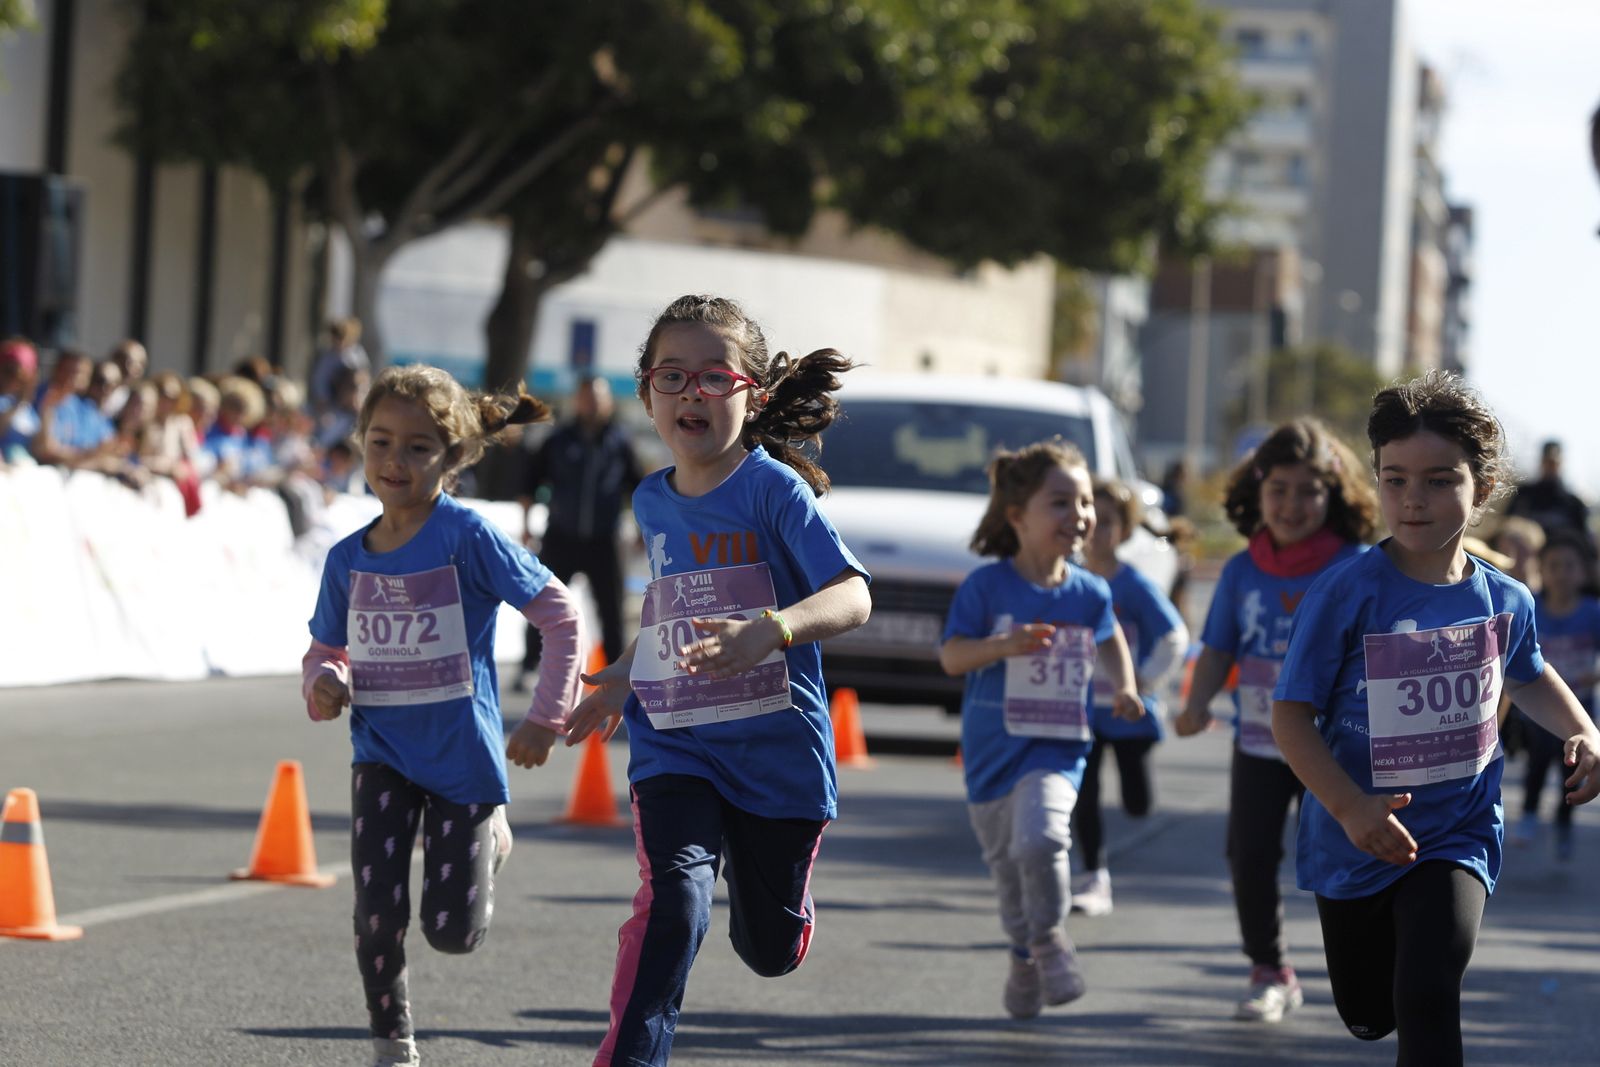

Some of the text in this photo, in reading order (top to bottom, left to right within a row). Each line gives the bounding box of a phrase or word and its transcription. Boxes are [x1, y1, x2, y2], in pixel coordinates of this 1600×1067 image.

[688, 532, 759, 565] VIII
[689, 574, 713, 587] VIII
[695, 606, 722, 614] NUESTRA
[356, 612, 441, 646] 3072
[1447, 629, 1474, 642] VIII
[368, 647, 422, 657] GOMINOLA
[1409, 665, 1442, 676] IGUALDAD
[1397, 666, 1494, 716] 3002
[1439, 711, 1469, 725] ALBA
[1342, 718, 1370, 736] LA IGU
[1374, 757, 1395, 766] NEXA
